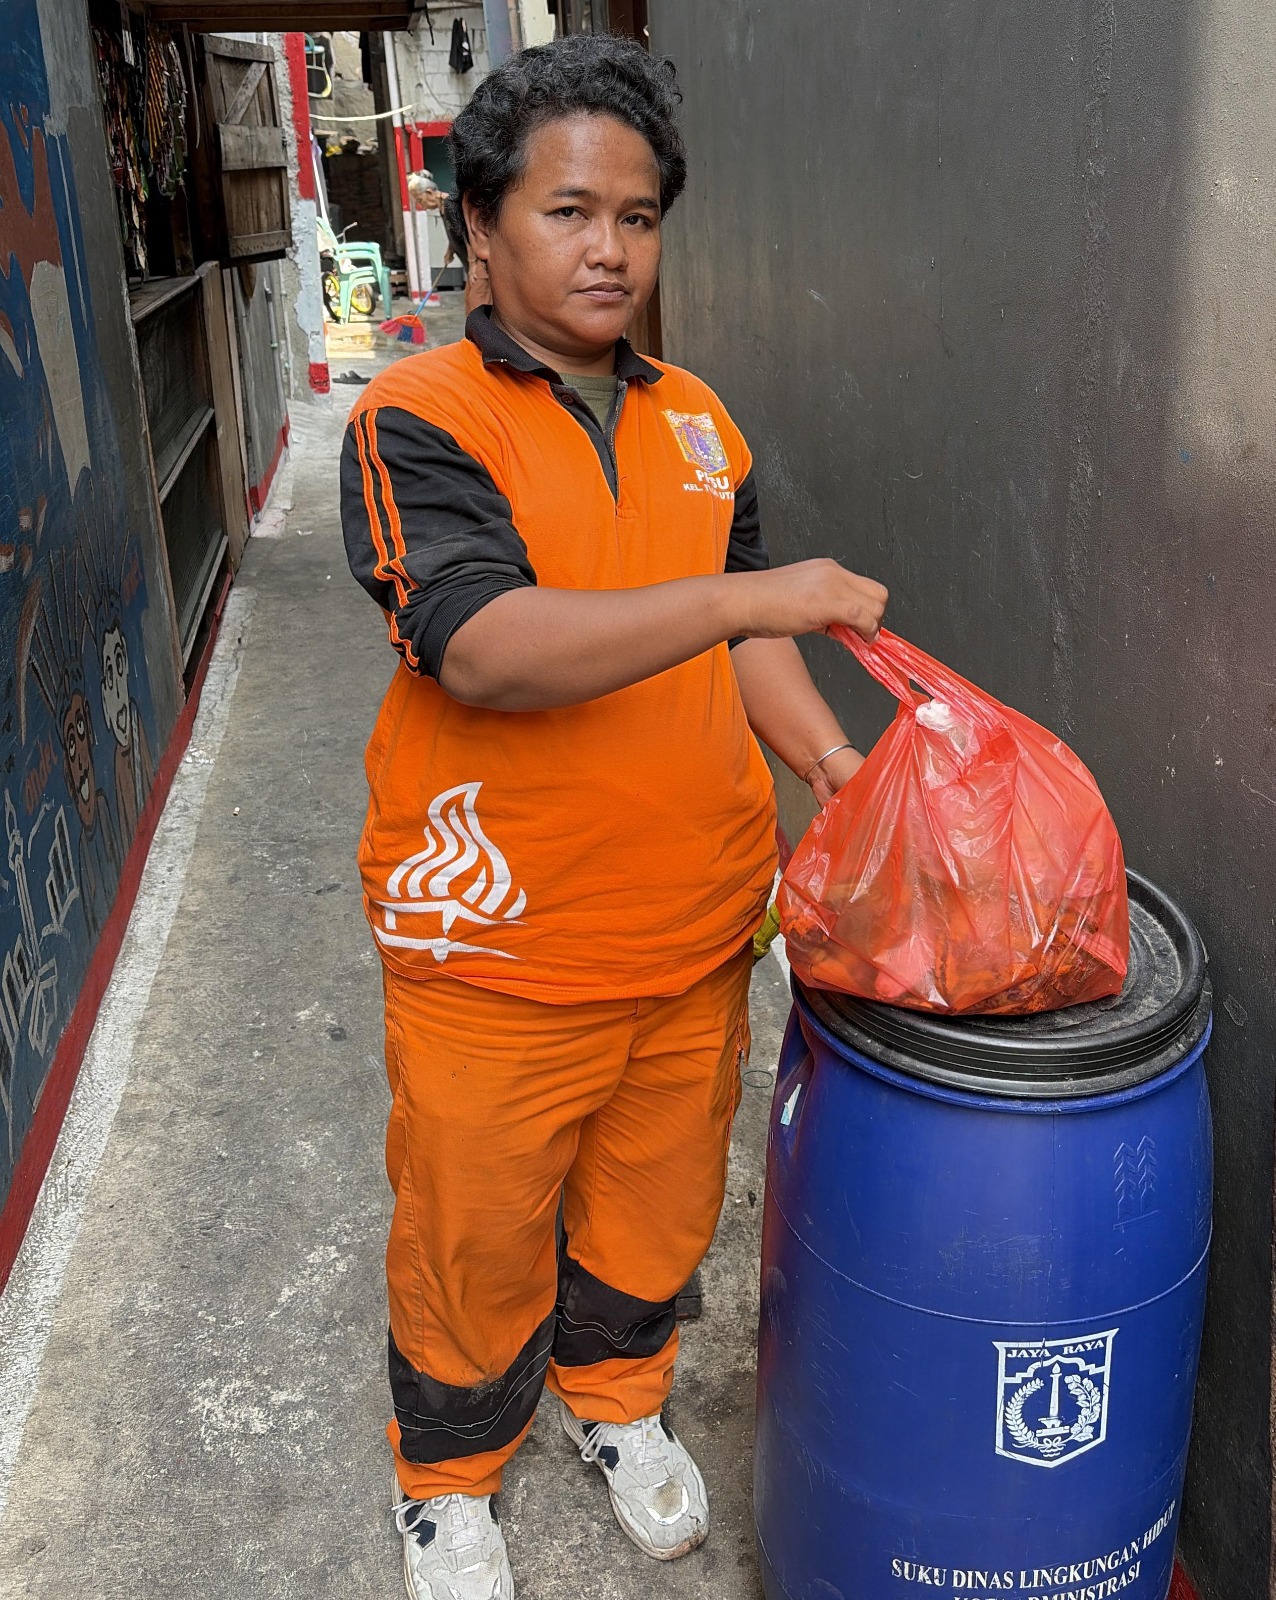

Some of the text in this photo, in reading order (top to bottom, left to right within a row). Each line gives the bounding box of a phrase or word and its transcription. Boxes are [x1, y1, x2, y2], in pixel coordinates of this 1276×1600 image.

[1007, 1339, 1104, 1358] JAYA RAYA
[891, 1499, 1176, 1589] SUKU DINAS LINGKUNGAN HIDUP
